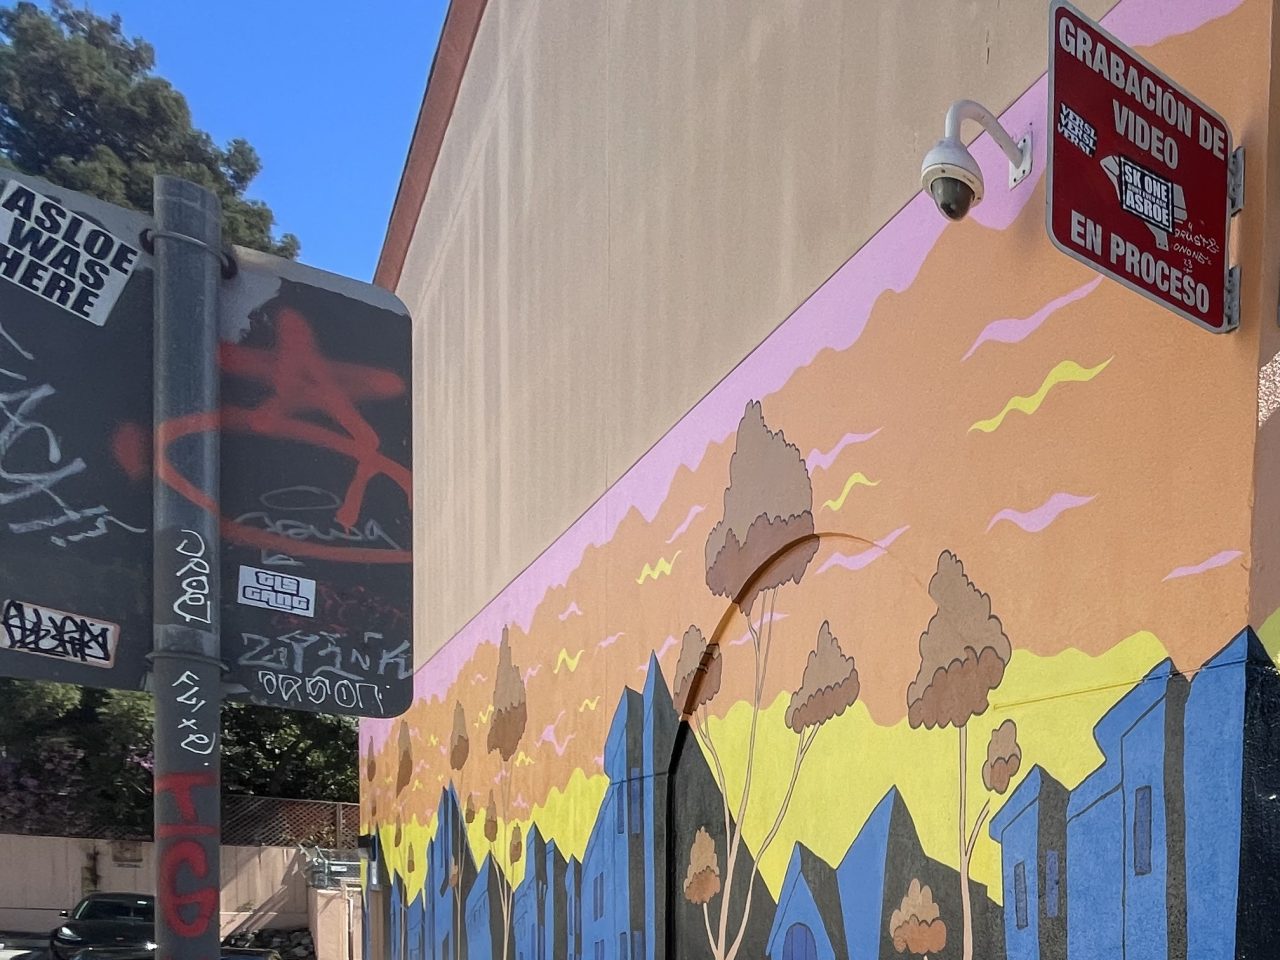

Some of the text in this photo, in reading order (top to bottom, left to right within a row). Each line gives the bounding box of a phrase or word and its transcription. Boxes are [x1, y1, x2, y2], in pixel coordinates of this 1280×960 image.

[1058, 16, 1225, 161] GRABACIÓN DE
[1112, 99, 1179, 170] VIDEO
[1124, 165, 1168, 203] SK ONE
[1126, 189, 1169, 226] ASROE
[2, 186, 138, 275] ASLOE
[8, 217, 110, 291] WAS
[1070, 209, 1209, 314] EN PROCESO
[0, 243, 100, 318] HERE
[243, 586, 310, 611] GANG
